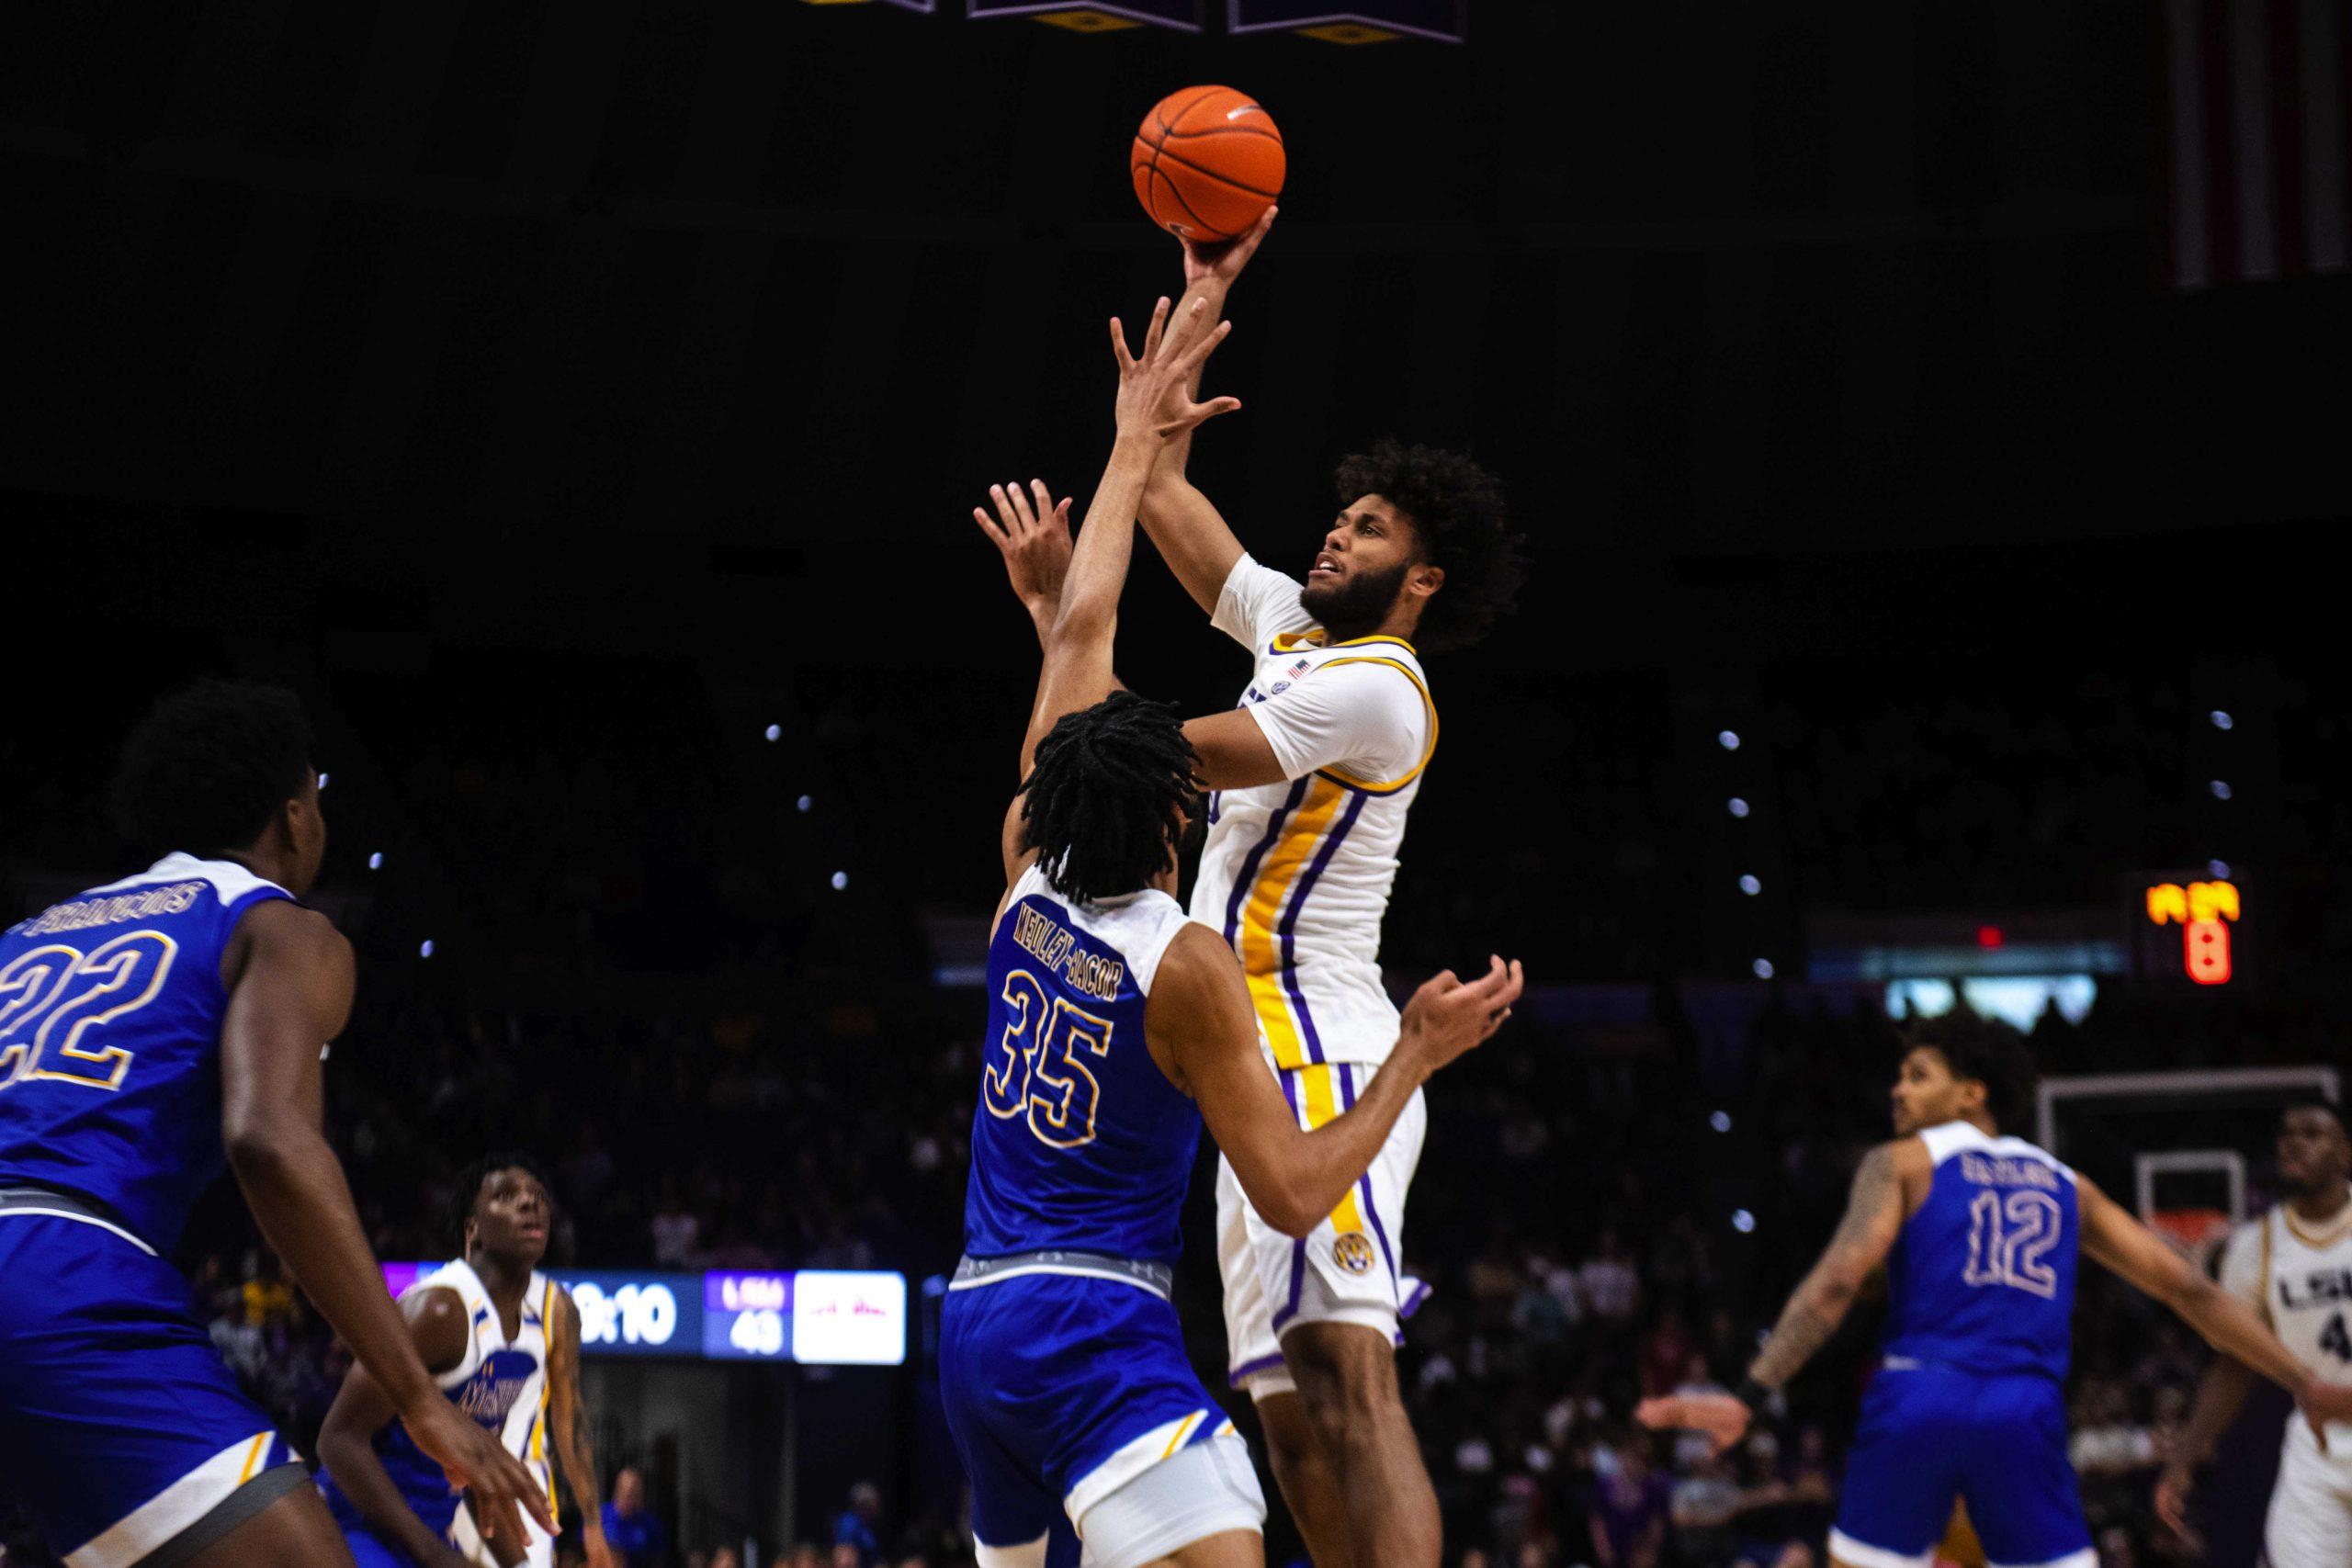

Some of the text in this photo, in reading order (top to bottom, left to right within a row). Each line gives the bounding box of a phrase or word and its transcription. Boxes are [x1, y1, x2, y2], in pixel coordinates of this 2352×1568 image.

[0, 930, 179, 1092] 22
[984, 969, 1114, 1148] 35
[1962, 1189, 2062, 1300] 12
[2318, 1311, 2352, 1363] 4
